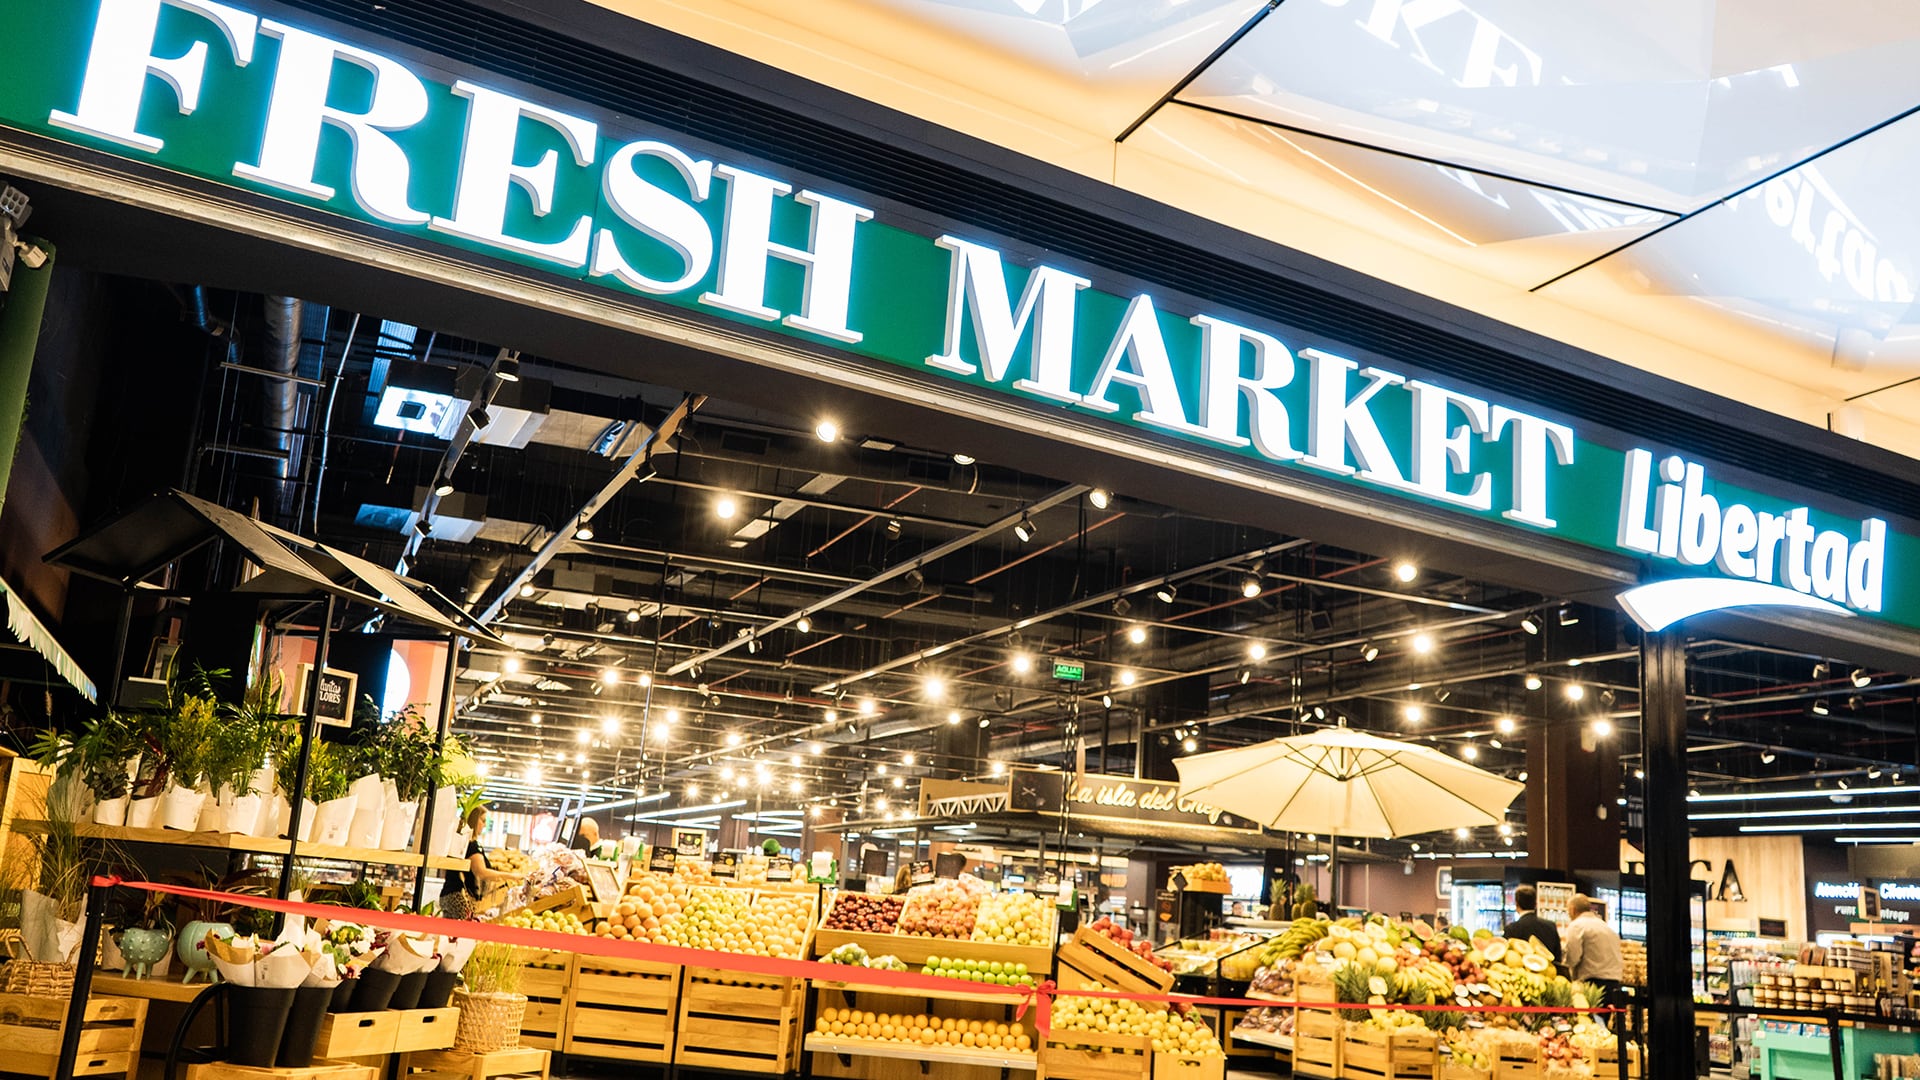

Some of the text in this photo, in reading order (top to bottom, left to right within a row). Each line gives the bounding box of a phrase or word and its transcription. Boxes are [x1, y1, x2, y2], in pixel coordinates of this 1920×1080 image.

[49, 0, 1574, 529] FRESH MARKET
[1616, 447, 1888, 613] Libertad
[320, 678, 341, 694] lantas
[320, 691, 341, 704] LORES
[1096, 783, 1137, 807] isla
[1138, 786, 1176, 811] del
[1880, 907, 1910, 922] ntrega
